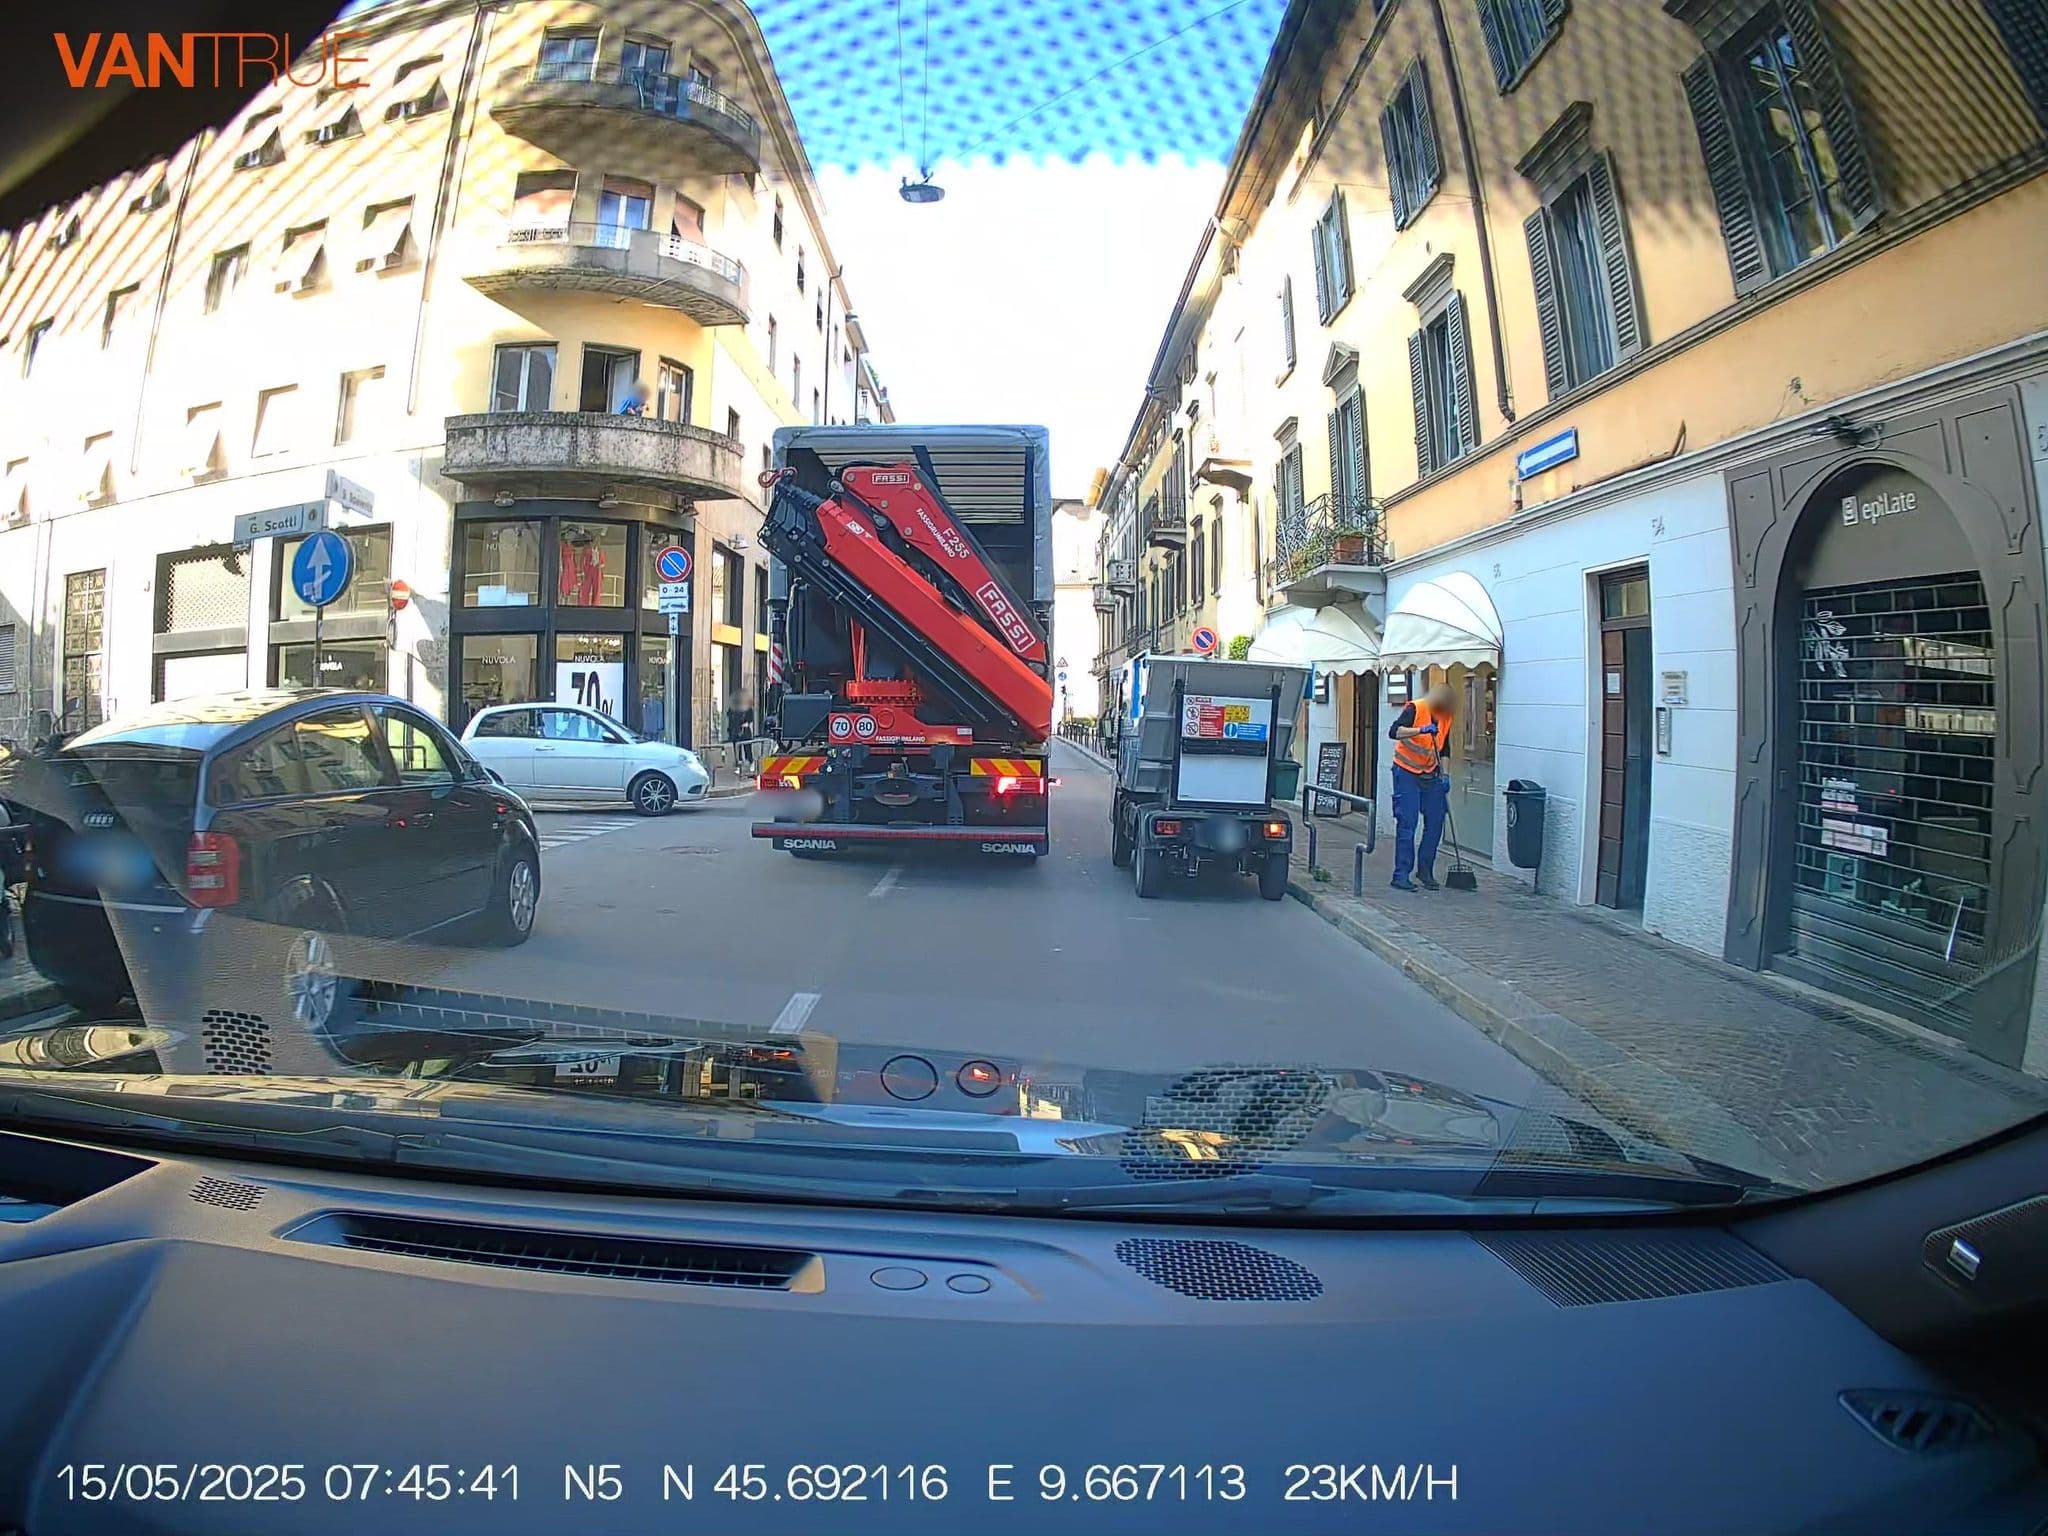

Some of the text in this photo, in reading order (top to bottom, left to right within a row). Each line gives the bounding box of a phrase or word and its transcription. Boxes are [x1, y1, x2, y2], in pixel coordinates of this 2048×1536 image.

[874, 474, 907, 482] FASSI
[249, 522, 261, 534] G.
[942, 527, 970, 559] F255
[662, 586, 669, 594] 0
[982, 589, 1029, 646] FASSI
[481, 655, 516, 665] NUVOLA
[834, 721, 848, 732] 70
[859, 721, 873, 732] 80
[783, 839, 837, 850] SCANIA
[981, 842, 1036, 854] SCANIA
